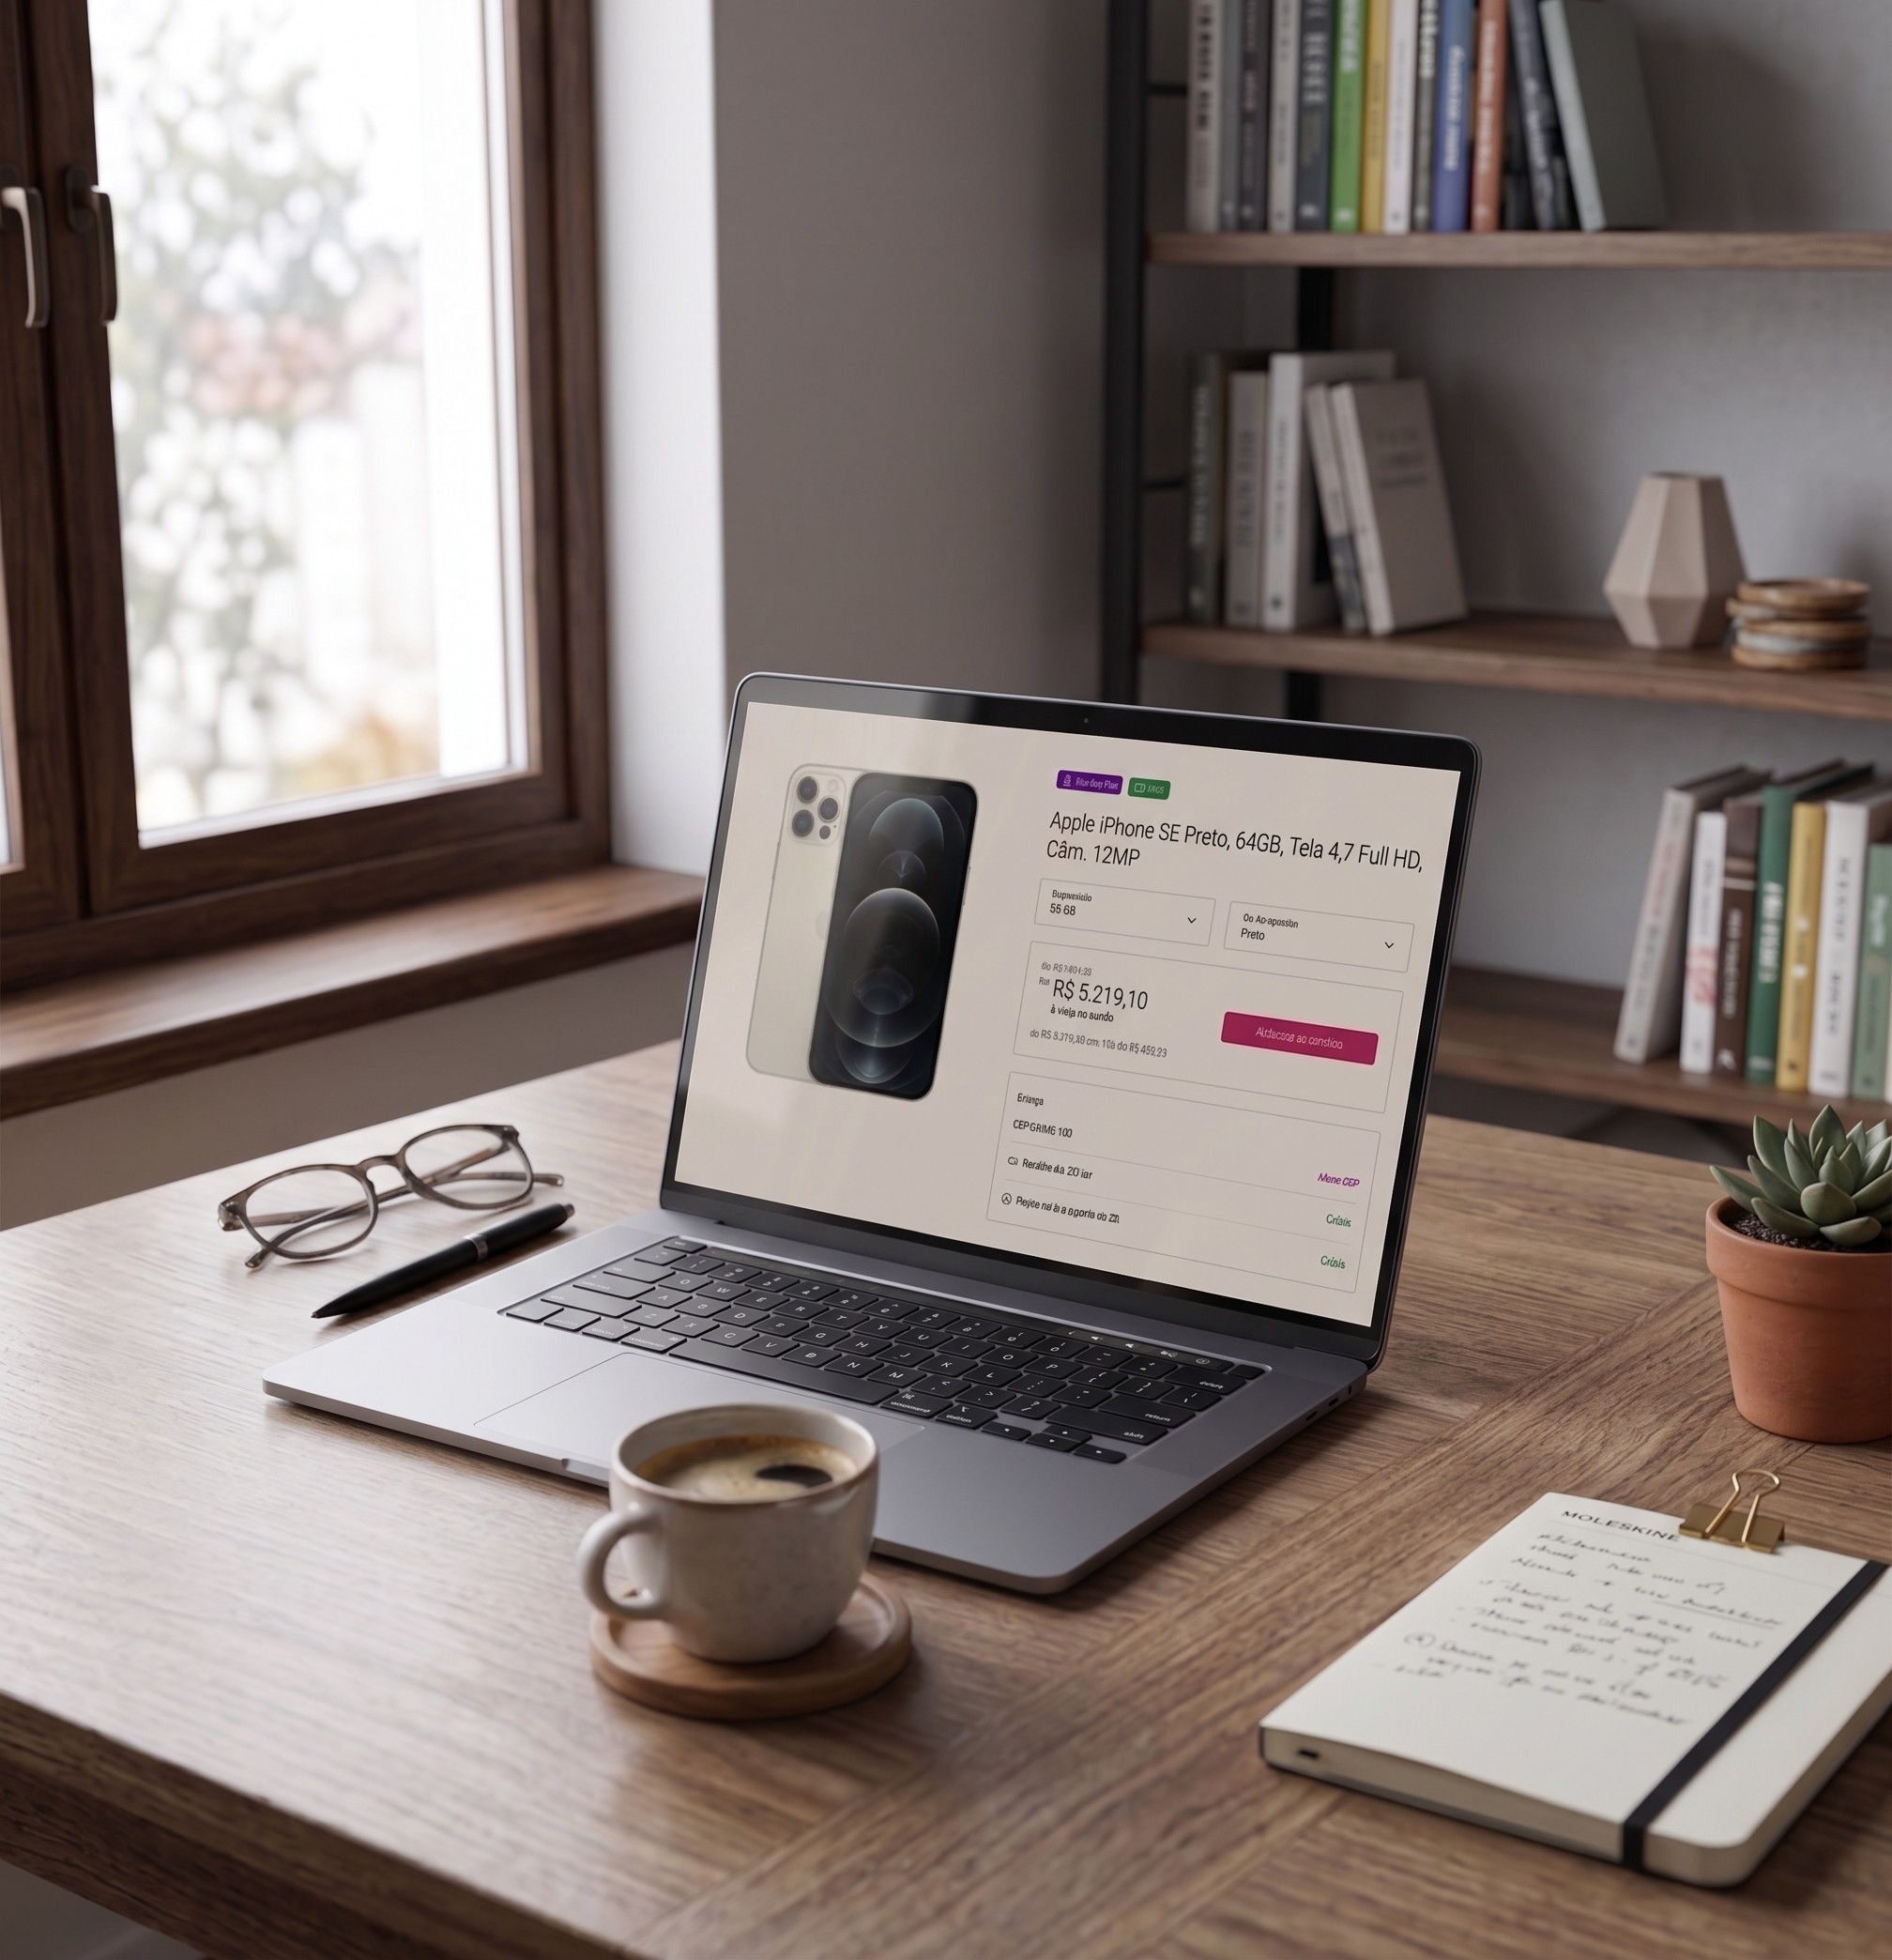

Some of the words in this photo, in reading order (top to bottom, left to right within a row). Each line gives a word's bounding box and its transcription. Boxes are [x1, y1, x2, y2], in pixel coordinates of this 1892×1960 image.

[1049, 811, 1095, 835] Apple
[1099, 816, 1154, 838] iPhone
[1158, 822, 1181, 842] SE
[1184, 825, 1230, 850] Preto,
[1235, 831, 1284, 857] 64GB,
[1289, 836, 1323, 858] Tela
[1328, 841, 1355, 864] 4,7
[1358, 844, 1390, 866] Full
[1393, 848, 1423, 873] HD,
[1046, 839, 1087, 861] Câm.
[1093, 845, 1140, 866] 12MP
[1062, 904, 1076, 916] 68
[1241, 927, 1265, 941] Preto
[1053, 978, 1076, 1002] R$
[1078, 983, 1149, 1010] 5.219,10
[1077, 1010, 1088, 1019] no
[1117, 1041, 1128, 1051] do
[1013, 1119, 1030, 1130] CEP
[1058, 1127, 1073, 1138] 100
[1342, 1176, 1360, 1187] CEP
[1562, 1510, 1680, 1542] MOLESKINE
